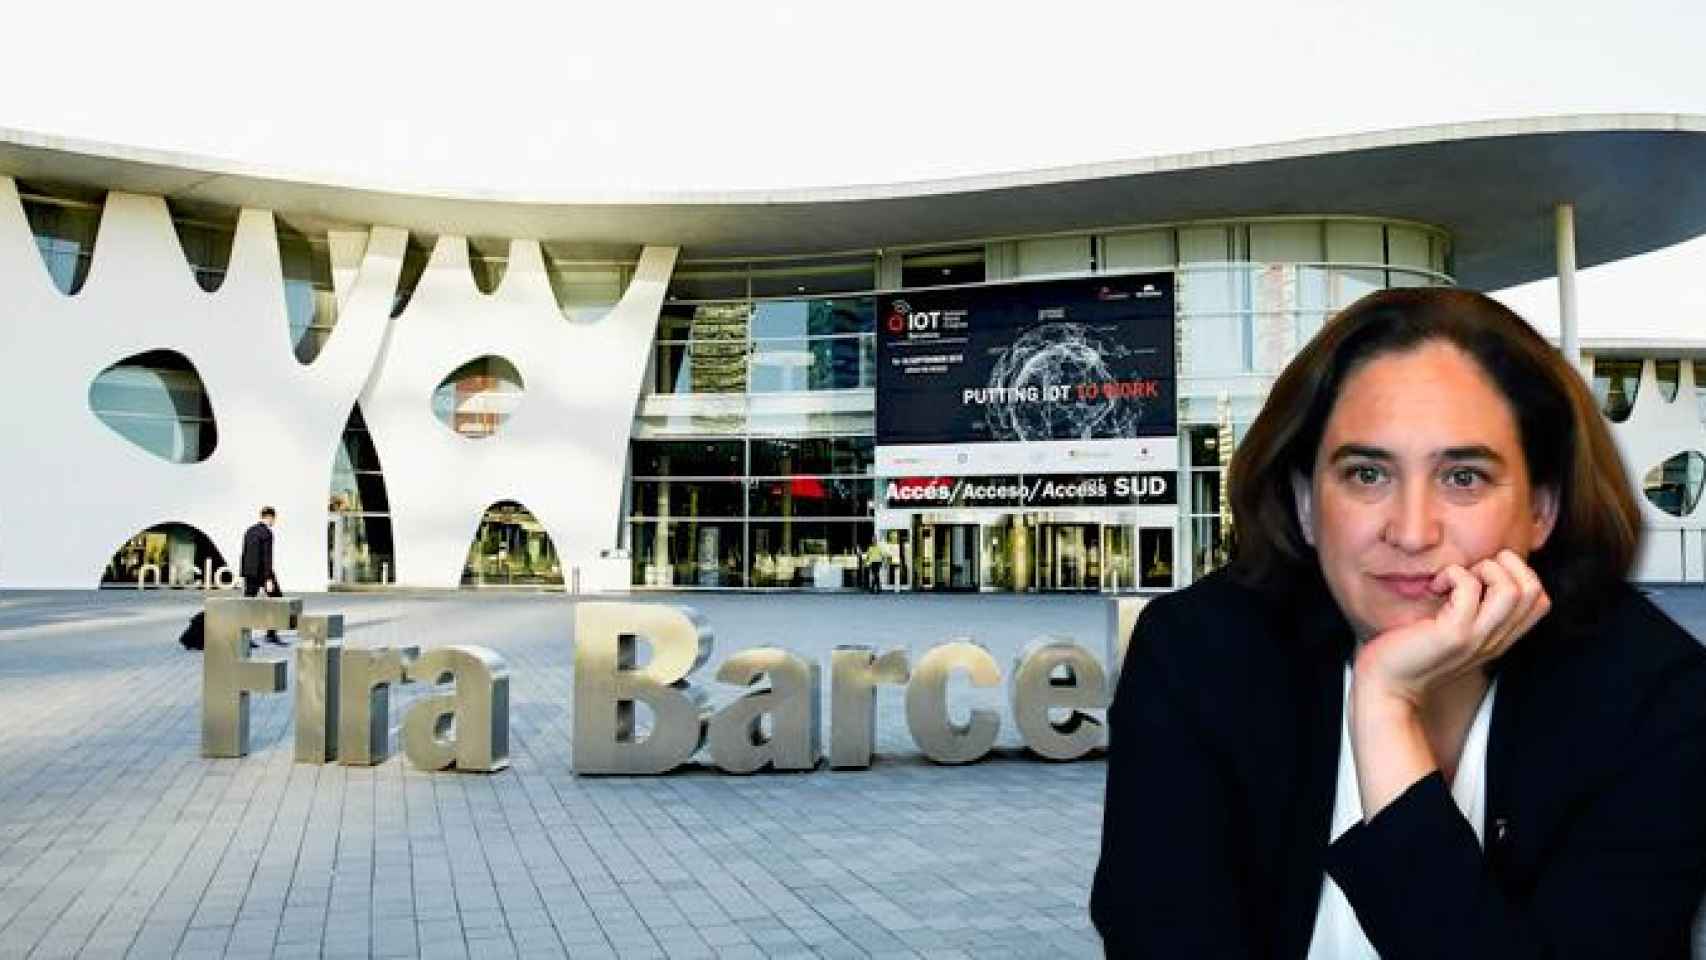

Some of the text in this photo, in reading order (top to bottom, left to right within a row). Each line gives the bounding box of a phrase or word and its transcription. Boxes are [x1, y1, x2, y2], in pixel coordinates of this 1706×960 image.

[908, 312, 940, 331] IOT
[963, 387, 1038, 404] PUTTING
[1114, 475, 1167, 496] SUD
[203, 599, 511, 772] Fira
